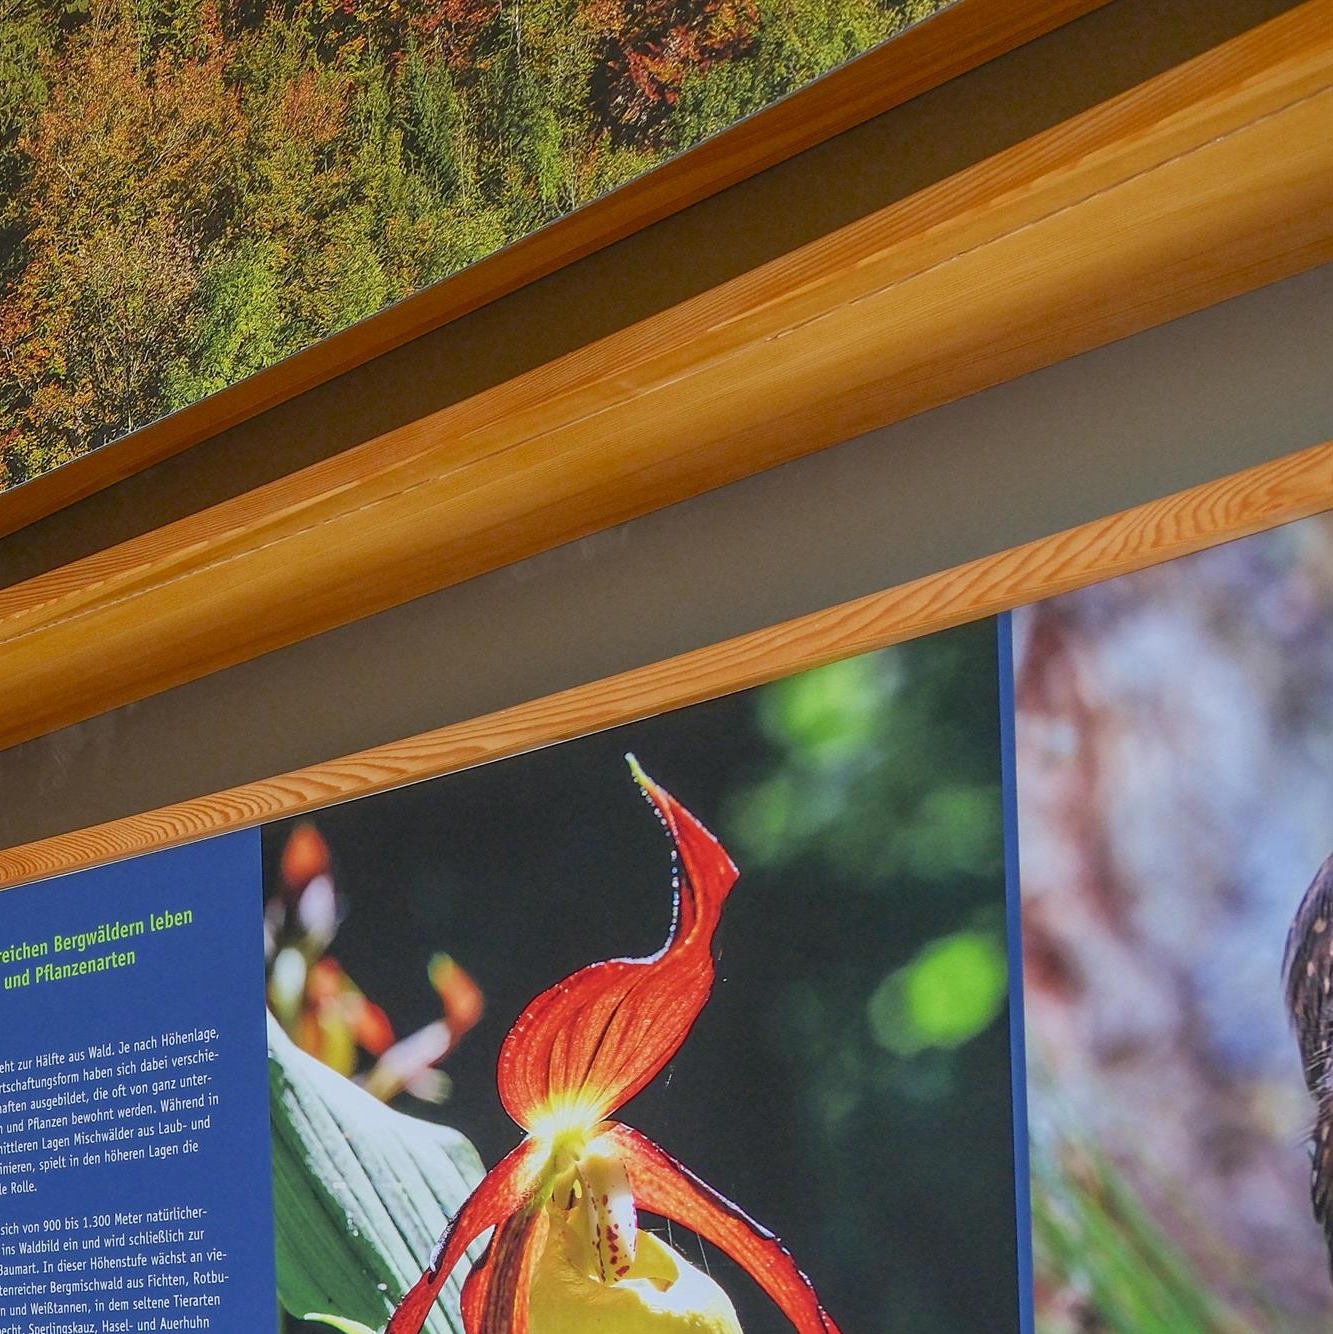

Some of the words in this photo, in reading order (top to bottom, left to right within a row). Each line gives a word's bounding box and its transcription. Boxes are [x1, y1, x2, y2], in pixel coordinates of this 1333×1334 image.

[54, 921, 144, 952] Bergwäldern
[150, 910, 192, 931] leben
[4, 968, 30, 989] und
[35, 951, 135, 982] Pflanzenarten
[17, 1059, 32, 1070] zur
[35, 1052, 65, 1067] Hälfte
[68, 1051, 85, 1062] aus
[88, 1043, 115, 1058] Wald.
[118, 1041, 130, 1054] Je
[133, 1036, 157, 1051] nach
[161, 1029, 219, 1046] Höhenlage,
[83, 1066, 112, 1081] haben
[116, 1061, 136, 1076] sich
[140, 1055, 167, 1072] dabei
[171, 1048, 219, 1066] verschie-
[30, 1091, 89, 1110] ausgebildet,
[93, 1087, 108, 1101] die
[111, 1083, 127, 1098] oft
[129, 1083, 148, 1095] von
[151, 1079, 176, 1095] ganz
[179, 1074, 212, 1088] unter-
[6, 1119, 24, 1133] und
[27, 1116, 68, 1130] Pflanzen
[71, 1108, 114, 1124] bewohnt
[117, 1103, 156, 1118] werden.
[160, 1093, 204, 1112] Während
[207, 1092, 219, 1106] in
[42, 1137, 70, 1151] Lagen
[74, 1127, 134, 1145] Mischwälder
[137, 1126, 155, 1137] aus
[158, 1119, 187, 1134] Laub-
[191, 1115, 210, 1130] und
[38, 1155, 66, 1173] spielt
[69, 1154, 79, 1167] in
[82, 1152, 100, 1165] den
[104, 1149, 145, 1162] höheren
[148, 1144, 178, 1159] Lagen
[182, 1139, 198, 1153] die
[10, 1180, 37, 1193] Rolle.
